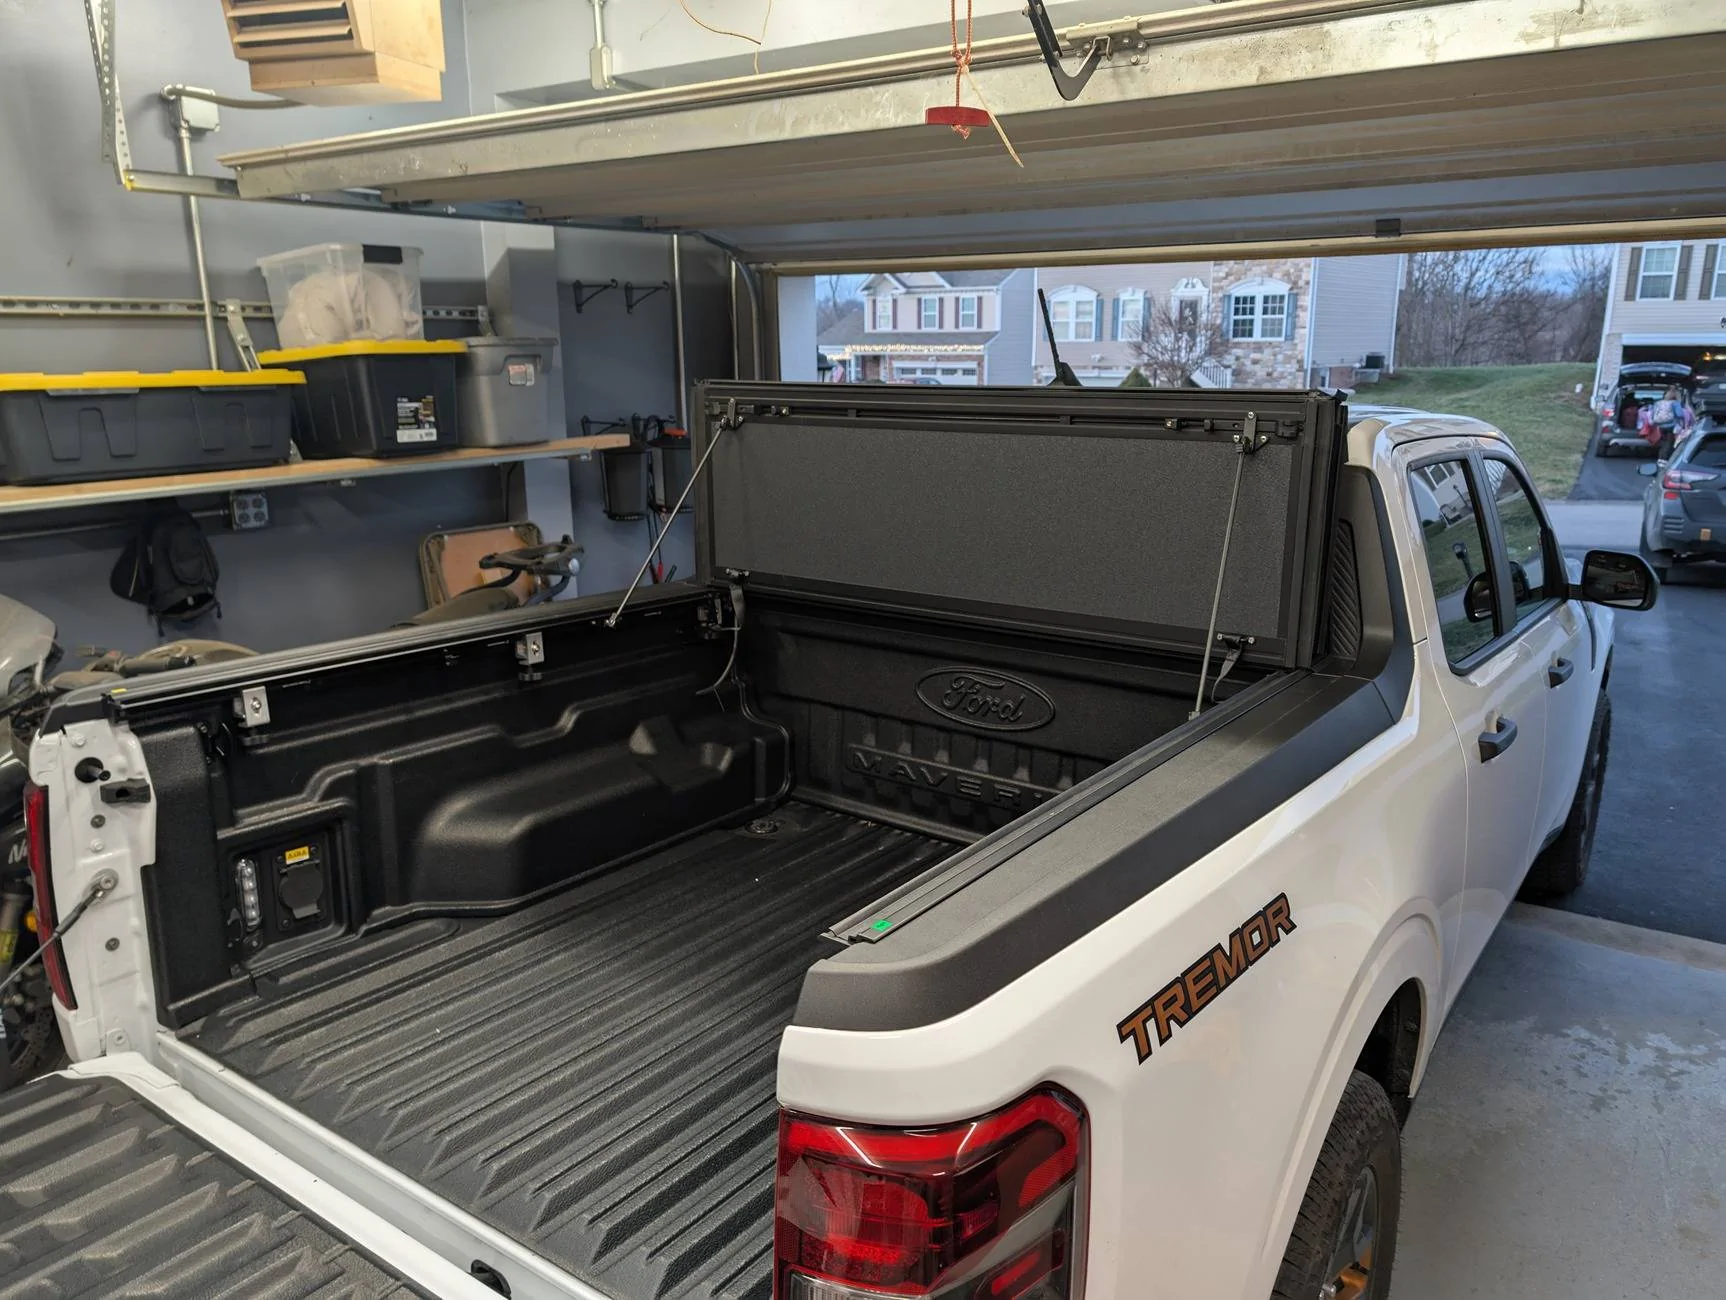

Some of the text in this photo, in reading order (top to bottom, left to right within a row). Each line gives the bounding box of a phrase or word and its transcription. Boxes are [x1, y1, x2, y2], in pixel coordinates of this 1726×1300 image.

[942, 673, 1026, 723] Ford
[853, 751, 1044, 809] MAVERI
[1116, 891, 1298, 1066] TREMOR
